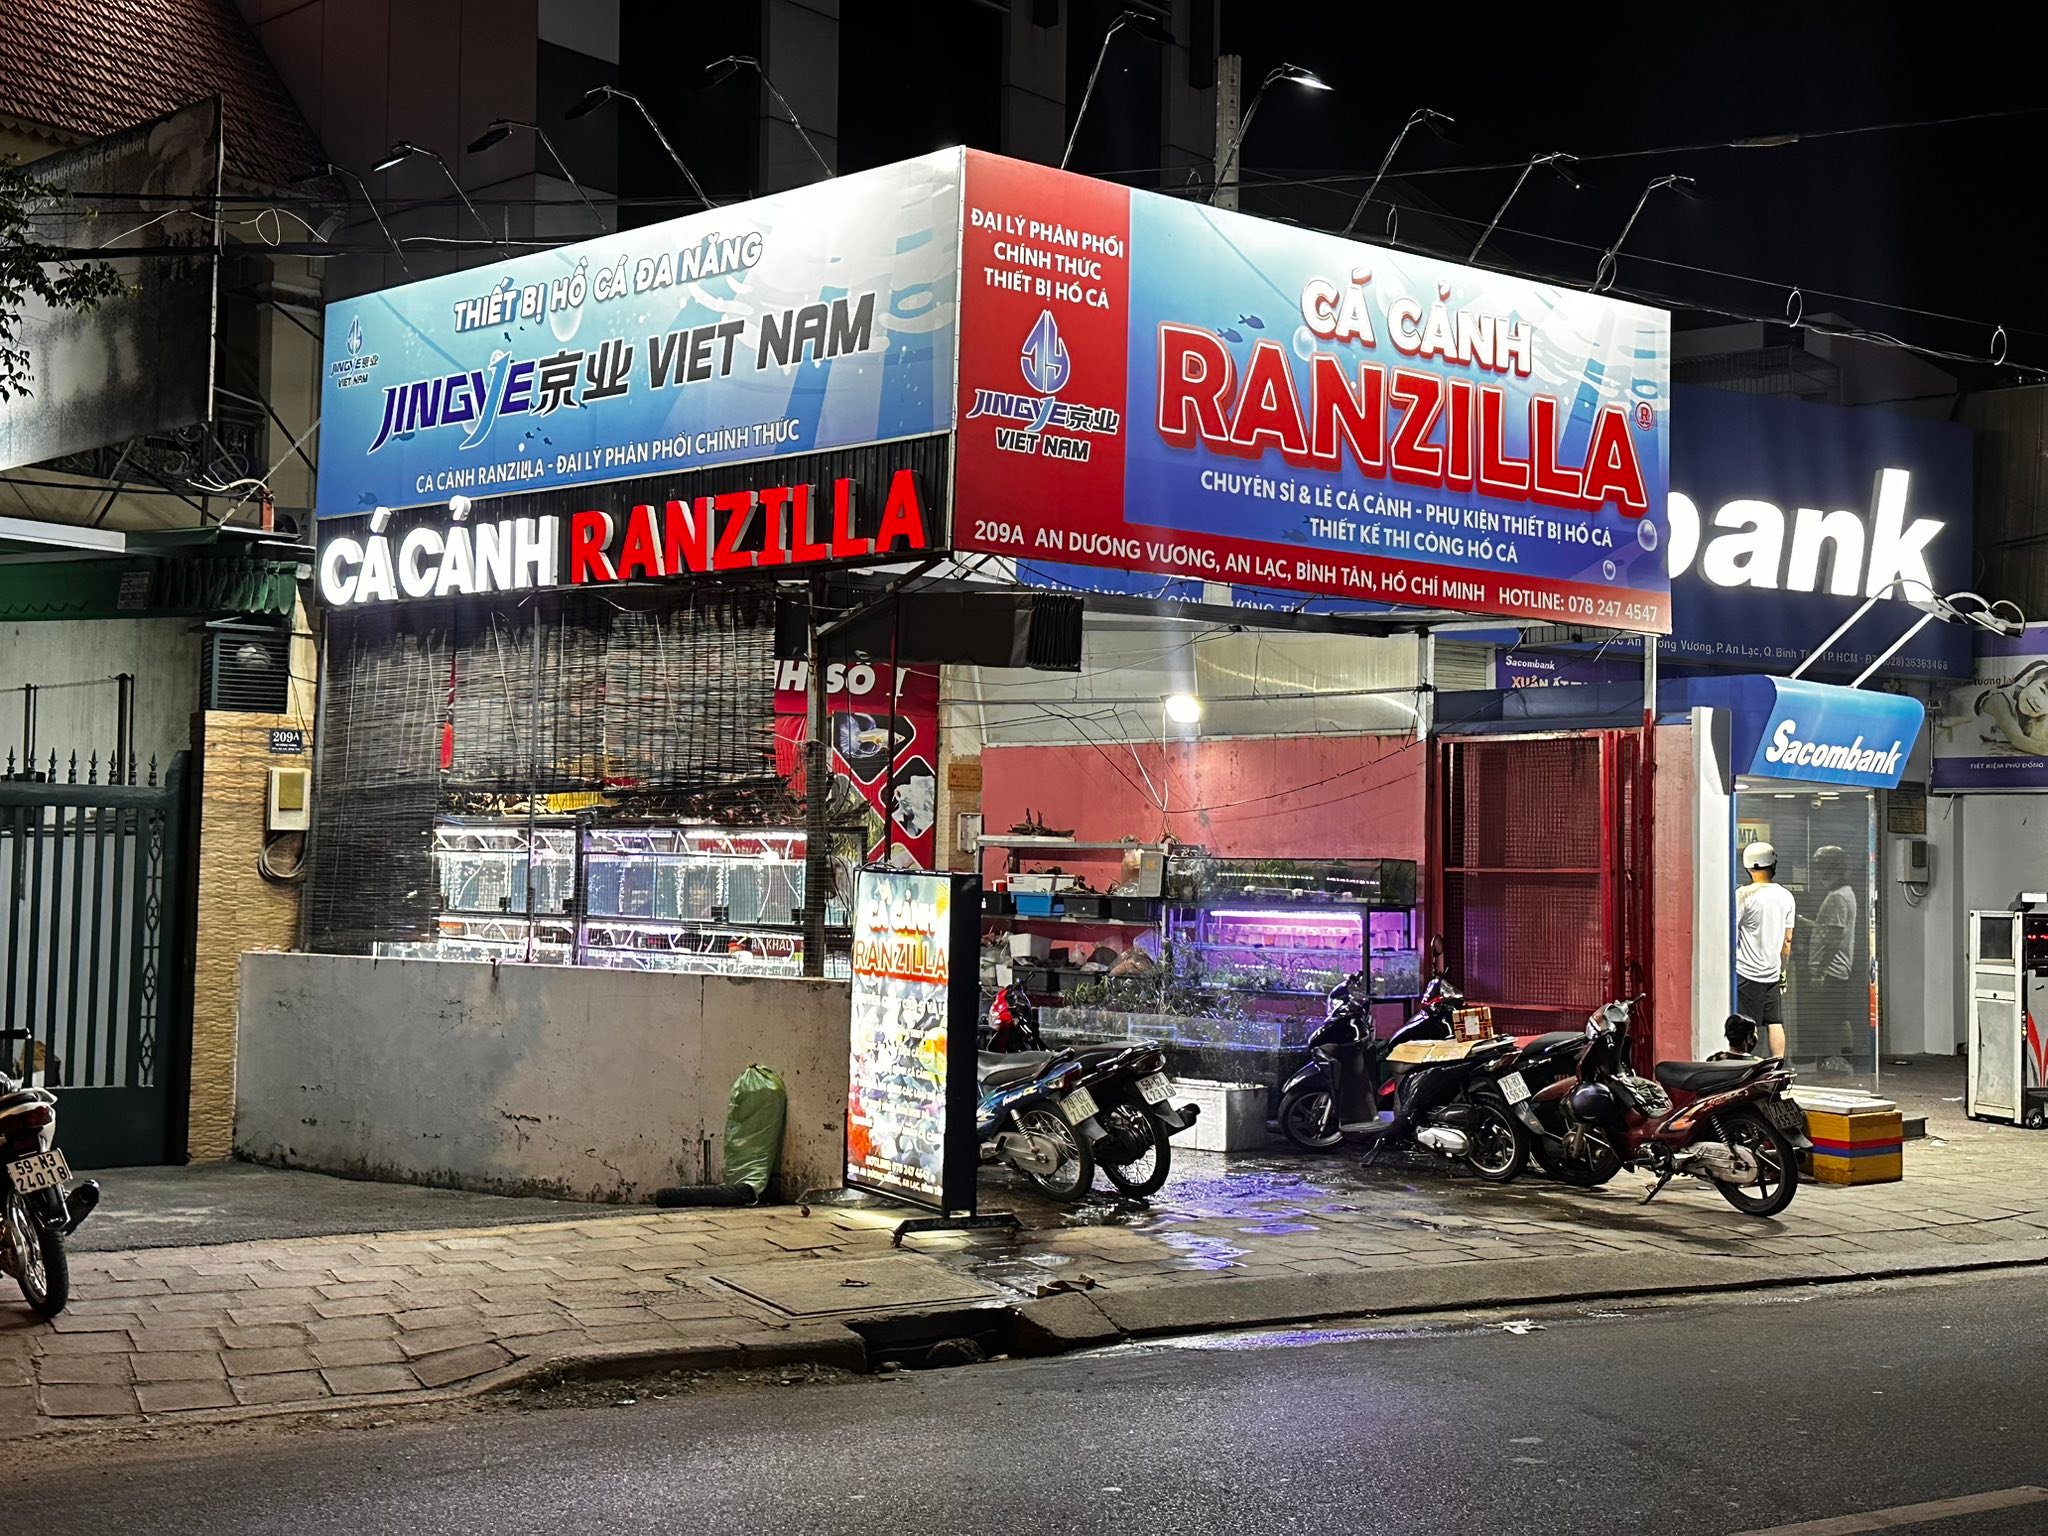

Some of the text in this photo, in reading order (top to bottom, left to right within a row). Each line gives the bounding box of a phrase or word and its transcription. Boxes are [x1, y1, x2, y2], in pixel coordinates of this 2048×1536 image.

[971, 207, 1002, 234] ĐẠI
[1006, 214, 1026, 236] LÝ
[1082, 232, 1124, 258] PHỐI
[454, 231, 764, 333] THIẾT BỊ HỒ CÁ ĐA NĂNG
[984, 267, 1032, 294] THIẾT
[1035, 278, 1052, 302] BỊ
[994, 241, 1102, 281] CHÍNH THỨC
[648, 312, 746, 389] VIET
[756, 293, 877, 374] NAM
[1300, 265, 1532, 376] CÁ CẢNH
[1157, 321, 1651, 515] RANZILLA
[437, 466, 475, 490] CẢNH
[478, 458, 544, 485] RANZILLA
[556, 452, 583, 478] ĐẠI
[586, 446, 602, 470] LÝ
[605, 440, 649, 467] PHÂN
[695, 427, 749, 454] CHÍNH
[752, 417, 801, 445] THỨC
[995, 427, 1091, 462] VIET NAM
[1201, 470, 1275, 500] CHUYÊN
[1298, 486, 1311, 505] &
[1336, 489, 1360, 513] CÁ
[1363, 493, 1412, 519] CẢNH
[1426, 503, 1459, 529] PHỤ
[1463, 508, 1500, 535] KIỆN
[1502, 511, 1544, 539] THIẾT
[1547, 518, 1563, 545] BỊ
[1591, 524, 1613, 548] CÁ
[318, 468, 932, 606] CÁ CẢNH RANZILLA
[1310, 516, 1519, 564] THIẾT KẾ THI CÔNG HỒ CÁ
[974, 519, 1658, 623] 209A AN DƯƠNG VƯƠNG, AN LẠC, BÌNH TÂN, HỒ CHÍ MINH HOTLINE: 078 247 4547
[1505, 655, 1556, 670] Sacombank
[1680, 639, 1714, 655] Vương,
[272, 731, 300, 743] 209A
[1765, 719, 1902, 777] Sacombank
[854, 940, 947, 982] RANZILLA
[15, 1153, 56, 1175] 59-N3
